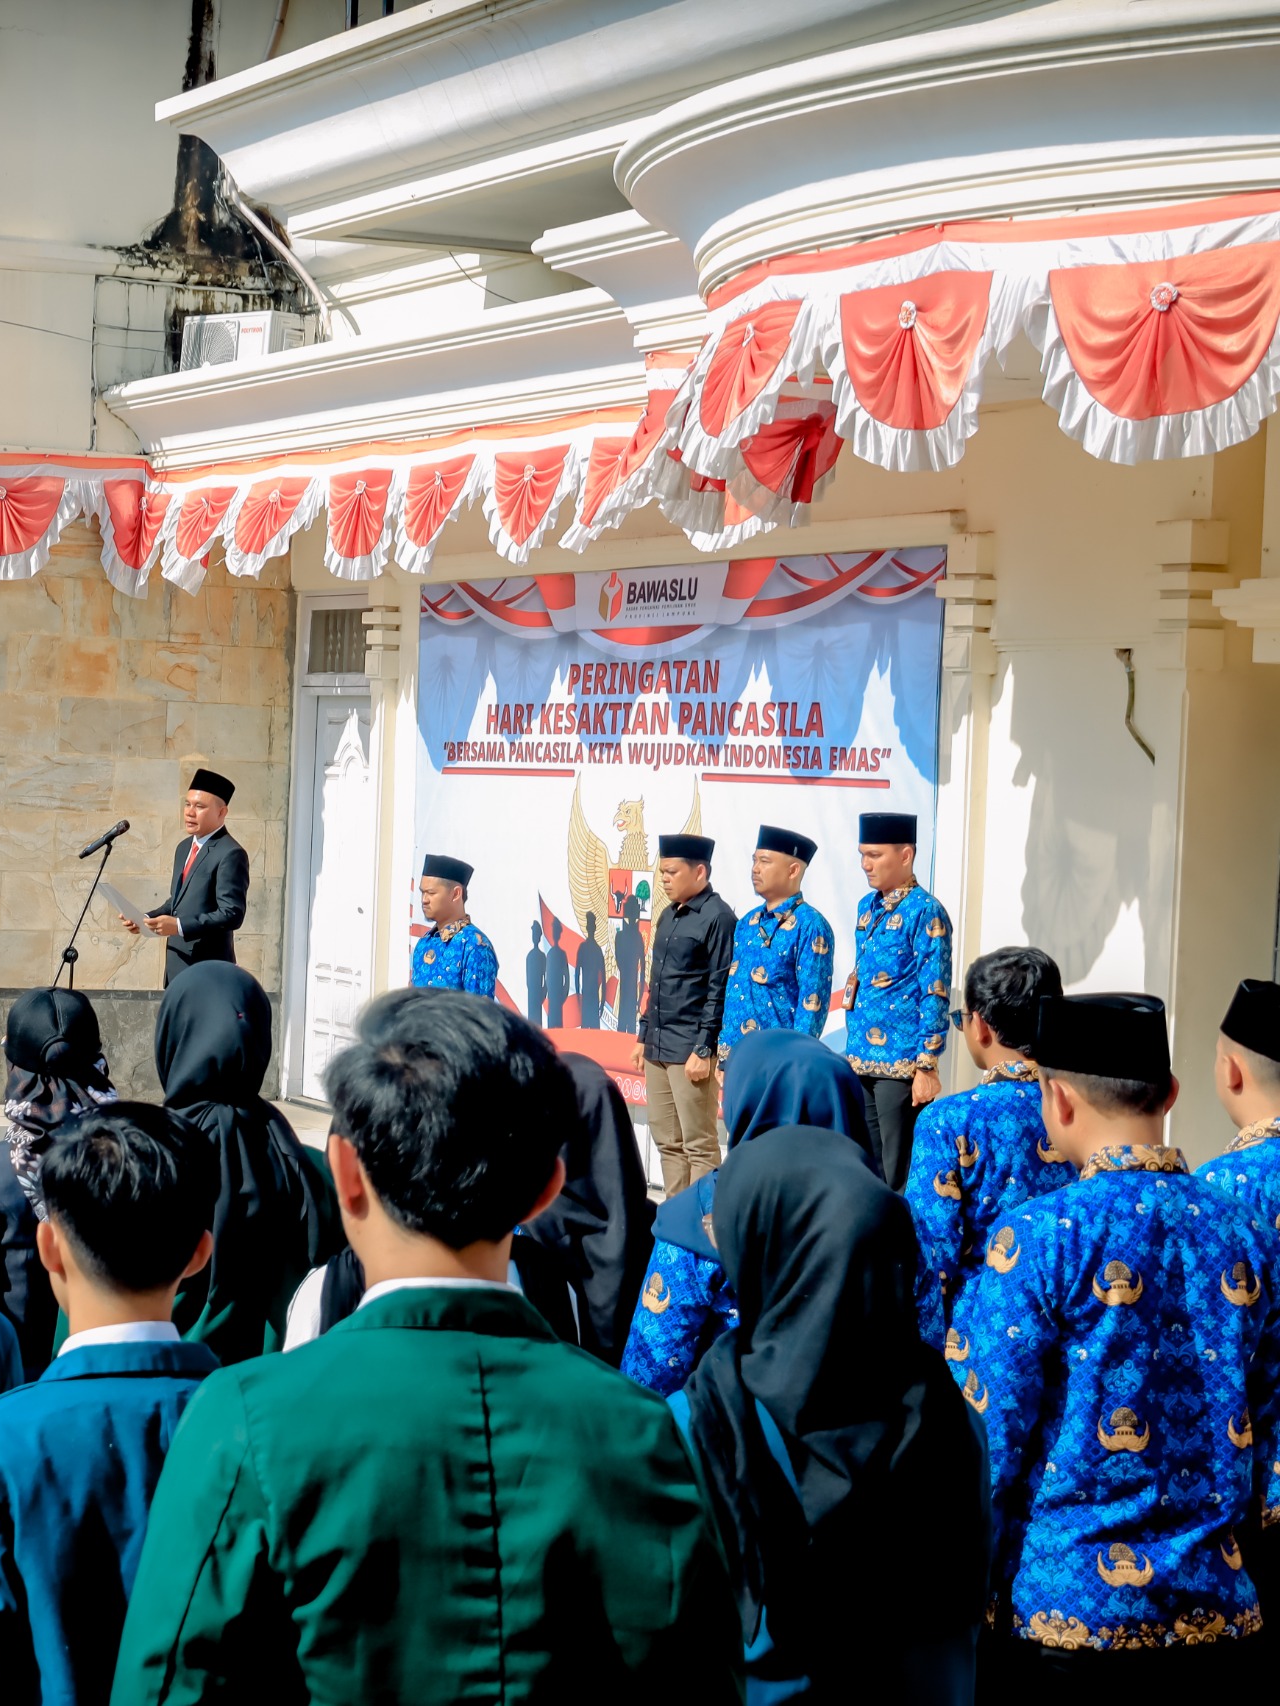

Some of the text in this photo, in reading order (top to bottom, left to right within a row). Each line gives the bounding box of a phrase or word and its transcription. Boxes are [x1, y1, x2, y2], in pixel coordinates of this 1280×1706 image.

[627, 577, 698, 604] BAWASLU
[567, 659, 720, 695] PERINGATAN
[485, 701, 824, 738] HARI KESAKTIAN PANCASILA
[508, 741, 584, 764] PANCASILA
[587, 742, 623, 765] KITA
[627, 742, 719, 771] WUJUDKAN
[723, 744, 822, 770] INDONESIA
